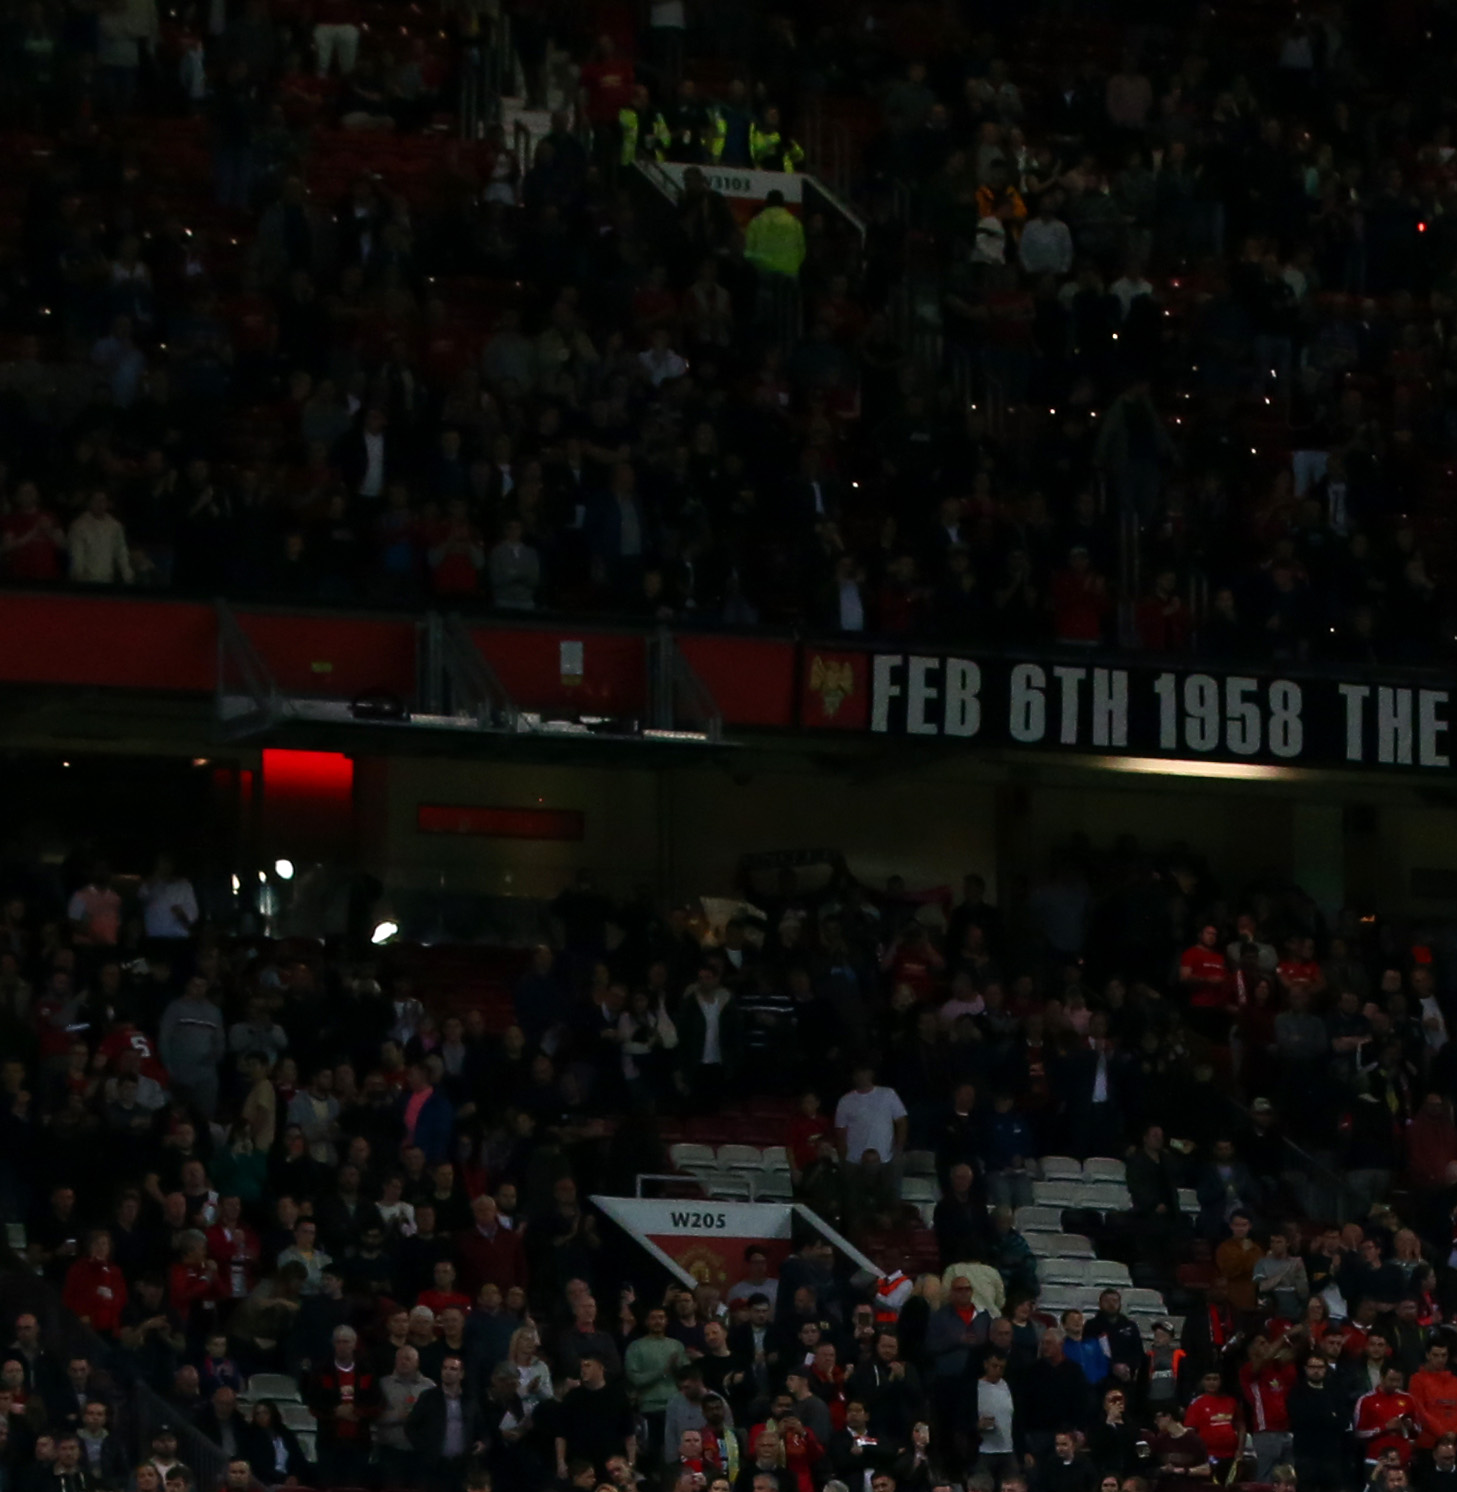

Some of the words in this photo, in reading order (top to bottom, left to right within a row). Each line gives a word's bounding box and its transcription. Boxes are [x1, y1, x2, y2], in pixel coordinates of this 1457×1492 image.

[870, 653, 982, 738] FEB
[1008, 663, 1129, 748] 6TH
[1154, 671, 1304, 758] 1958
[1338, 682, 1451, 768] THE
[670, 1211, 727, 1229] W205
